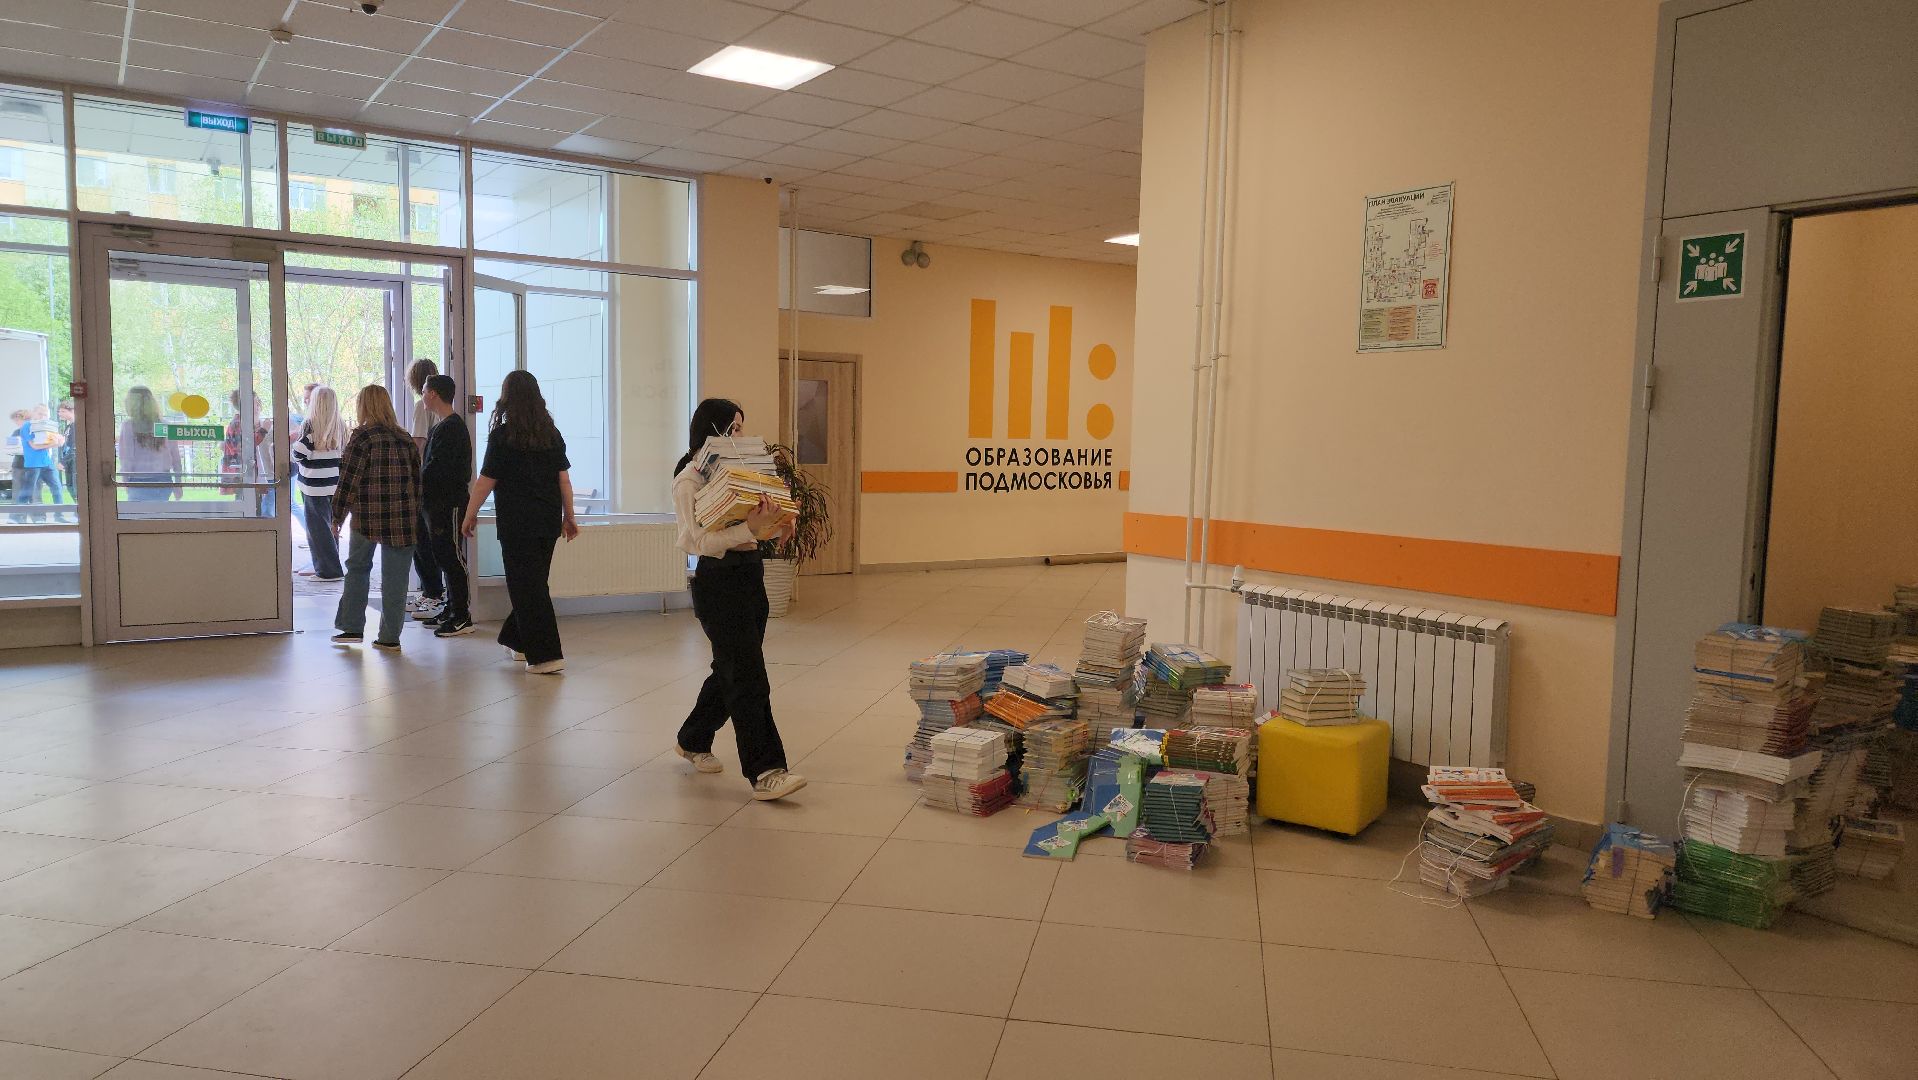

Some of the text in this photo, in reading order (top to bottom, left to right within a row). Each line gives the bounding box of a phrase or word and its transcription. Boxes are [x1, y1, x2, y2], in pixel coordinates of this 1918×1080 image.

[202, 115, 235, 129] ВЫХОД
[317, 131, 363, 148] ВЫХОД
[176, 427, 216, 439] ВЫХОД
[965, 447, 1113, 467] ОБРАЗОВАНИЕ
[965, 471, 1112, 493] ПОДМОСКОВЬЯ
